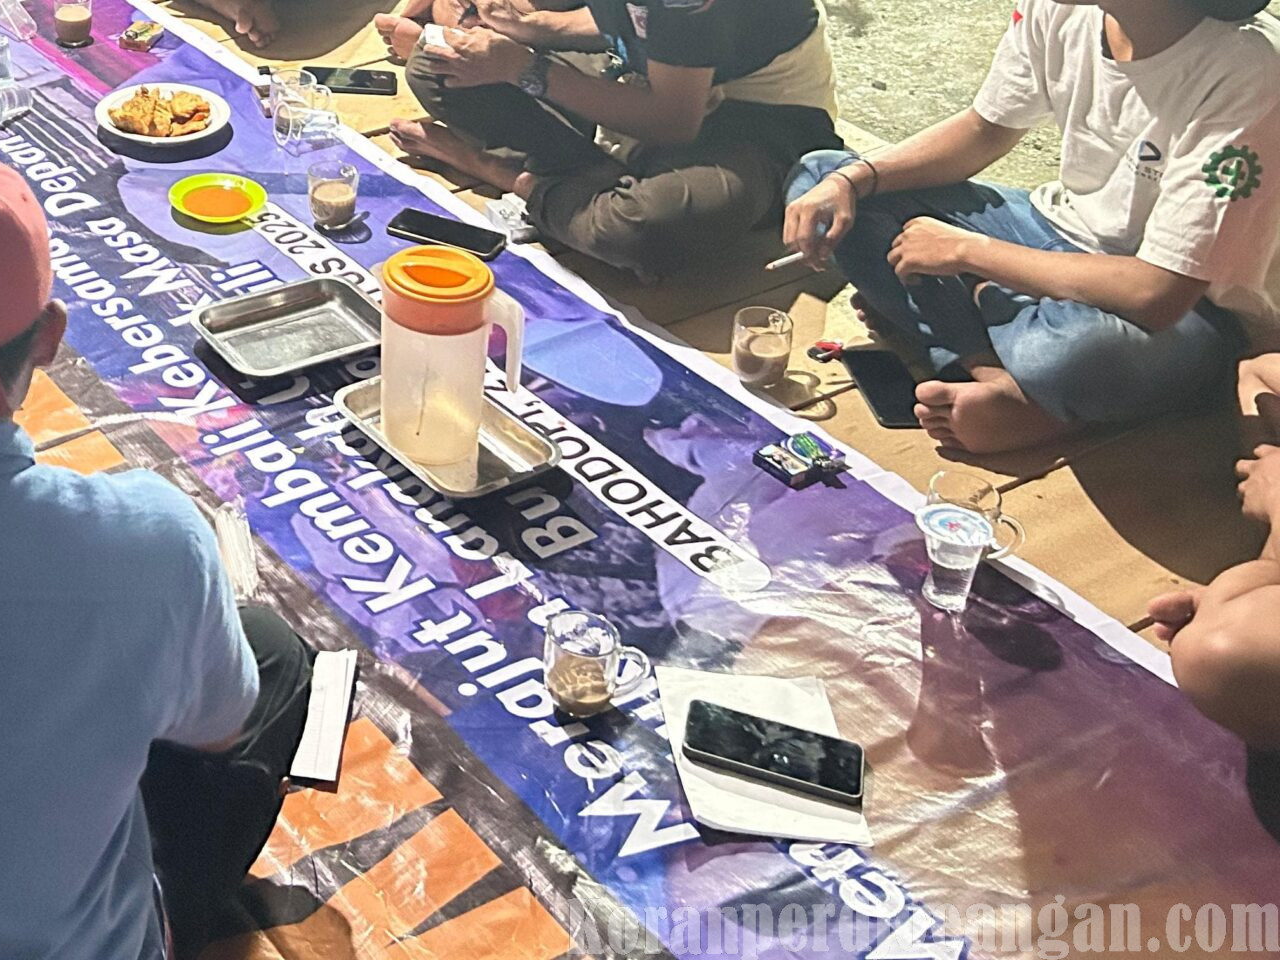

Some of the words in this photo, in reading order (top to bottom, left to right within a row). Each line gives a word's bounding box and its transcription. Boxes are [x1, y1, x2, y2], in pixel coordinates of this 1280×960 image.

[86, 215, 193, 298] Masa
[201, 418, 438, 616] Kembali
[410, 606, 701, 857] Merajut
